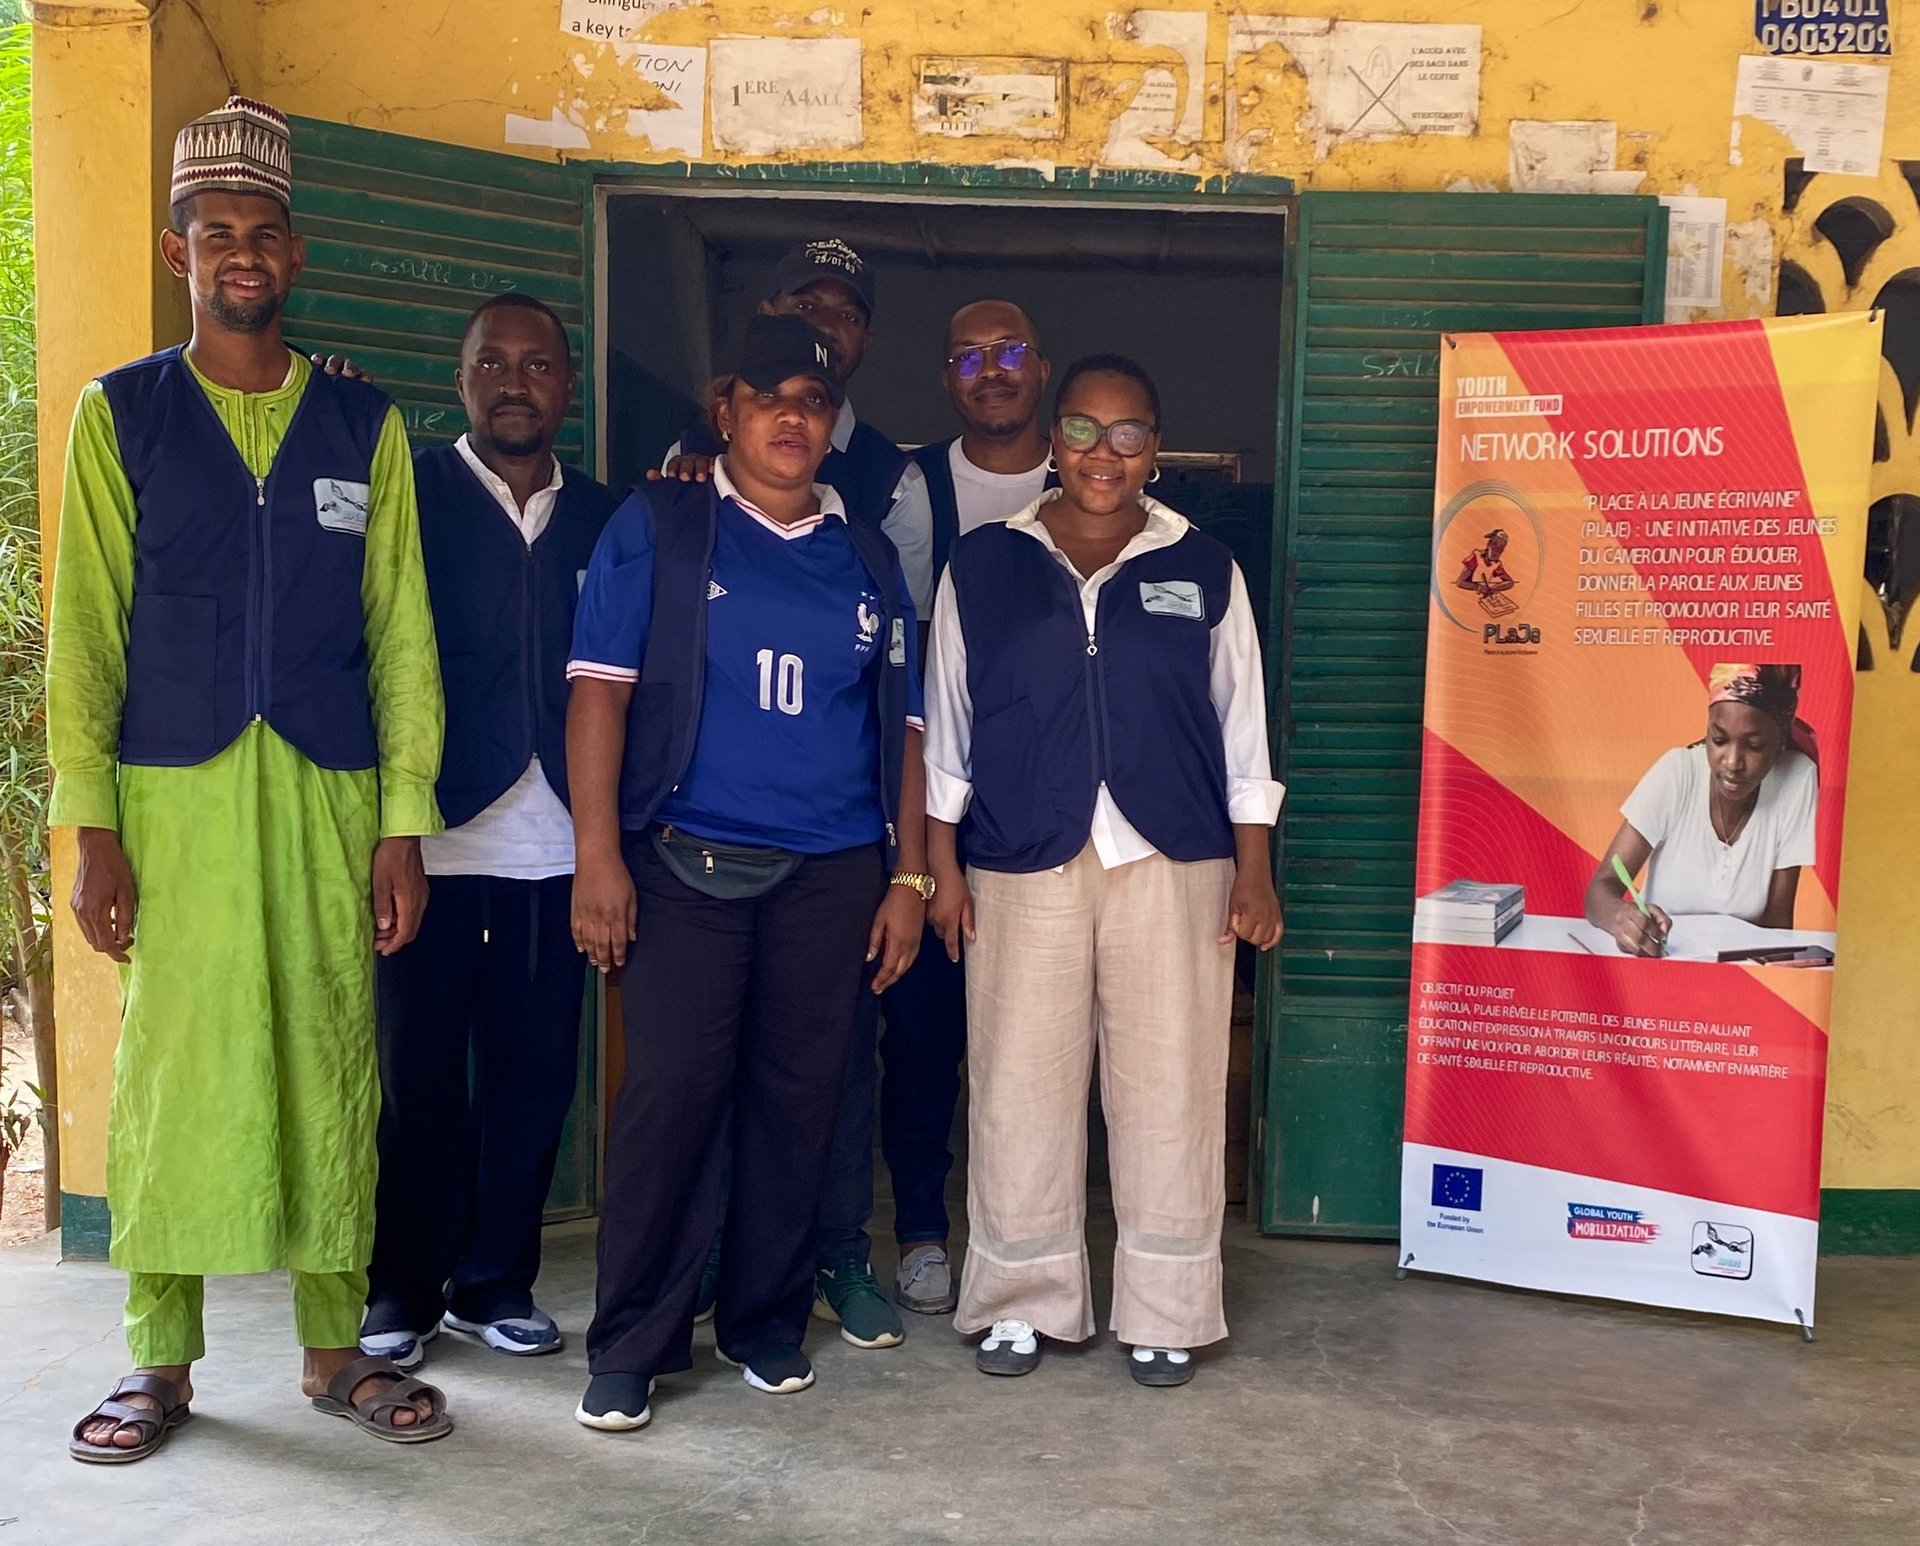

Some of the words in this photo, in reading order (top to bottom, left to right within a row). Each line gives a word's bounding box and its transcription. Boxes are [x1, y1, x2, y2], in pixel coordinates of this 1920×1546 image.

[572, 21, 581, 32] a
[586, 18, 614, 39] key
[1762, 22, 1890, 52] 0603209
[814, 342, 828, 368] N
[1456, 375, 1508, 397] YOUTH
[1457, 400, 1531, 415] EMPOWERMENT
[1533, 398, 1560, 412] FUND
[1460, 431, 1576, 462] NETWORK
[1583, 426, 1725, 459] SOLUTIONS
[1637, 490, 1648, 510] À
[1651, 493, 1669, 510] LA
[1671, 492, 1716, 510] JEUNE
[1581, 520, 1632, 540] (PLAJE)
[1645, 520, 1674, 537] UNE
[1677, 519, 1750, 537] INITIATIVE
[1753, 518, 1781, 536] DES
[1784, 517, 1838, 536] JEUNES
[1579, 548, 1600, 565] DU
[1603, 547, 1683, 565] CAMEROUN
[1685, 546, 1726, 564] POUR
[1730, 543, 1802, 565] ÉDUQUER,
[1577, 575, 1637, 592] DONNER
[1638, 574, 1657, 591] LA
[1659, 574, 1716, 592] PAROLE
[1718, 574, 1749, 591] AUX
[1750, 574, 1803, 591] JEUNES
[1576, 601, 1621, 618] FILLES
[1624, 601, 1642, 618] ET
[1644, 601, 1740, 619] PROMOUVOIR
[1744, 601, 1780, 619] LEUR
[1784, 598, 1832, 619] SANTÉ
[1574, 628, 1640, 645] SEXUELLE
[1643, 628, 1661, 645] ET
[855, 644, 870, 653] FFF
[757, 649, 803, 715] 10
[1420, 981, 1463, 995] OBJECTIF
[1464, 984, 1479, 996] DU
[1480, 986, 1515, 999] PROJET
[1473, 1003, 1501, 1017] PLAJE
[1538, 1008, 1549, 1021] LE
[1550, 1009, 1600, 1026] POTENTIEL
[1602, 1014, 1619, 1028] DES
[1622, 1016, 1656, 1031] JEUNES
[1659, 1019, 1691, 1034] FILLES
[1694, 1022, 1708, 1035] EN
[1709, 1023, 1752, 1038] ALLIANT
[1473, 1021, 1485, 1033] ET
[1485, 1022, 1544, 1039] EXPRESSION
[1553, 1027, 1596, 1043] TRAVERS
[1599, 1032, 1613, 1045] UN
[1614, 1034, 1668, 1050] CONCOURS
[1732, 1043, 1759, 1058] LEUR
[1417, 1052, 1430, 1065] DE
[1431, 1053, 1462, 1068] SANTÉ
[1464, 1056, 1506, 1072] SEXUELLE
[1507, 1060, 1519, 1073] ET
[1418, 1035, 1461, 1049] OFFRANT
[1462, 1038, 1480, 1051] UNE
[1481, 1040, 1504, 1053] VOIX
[1505, 1042, 1531, 1056] POUR
[1534, 1045, 1579, 1060] ABORDER
[1582, 1049, 1612, 1063] LEURS
[1663, 1057, 1726, 1074] NOTAMMENT
[1728, 1062, 1742, 1075] EN
[1743, 1063, 1789, 1080] MATIÈRE
[1573, 1206, 1605, 1218] GLOBAL
[1606, 1210, 1634, 1221] YOUTH
[1574, 1221, 1650, 1239] MOBILIZATION
